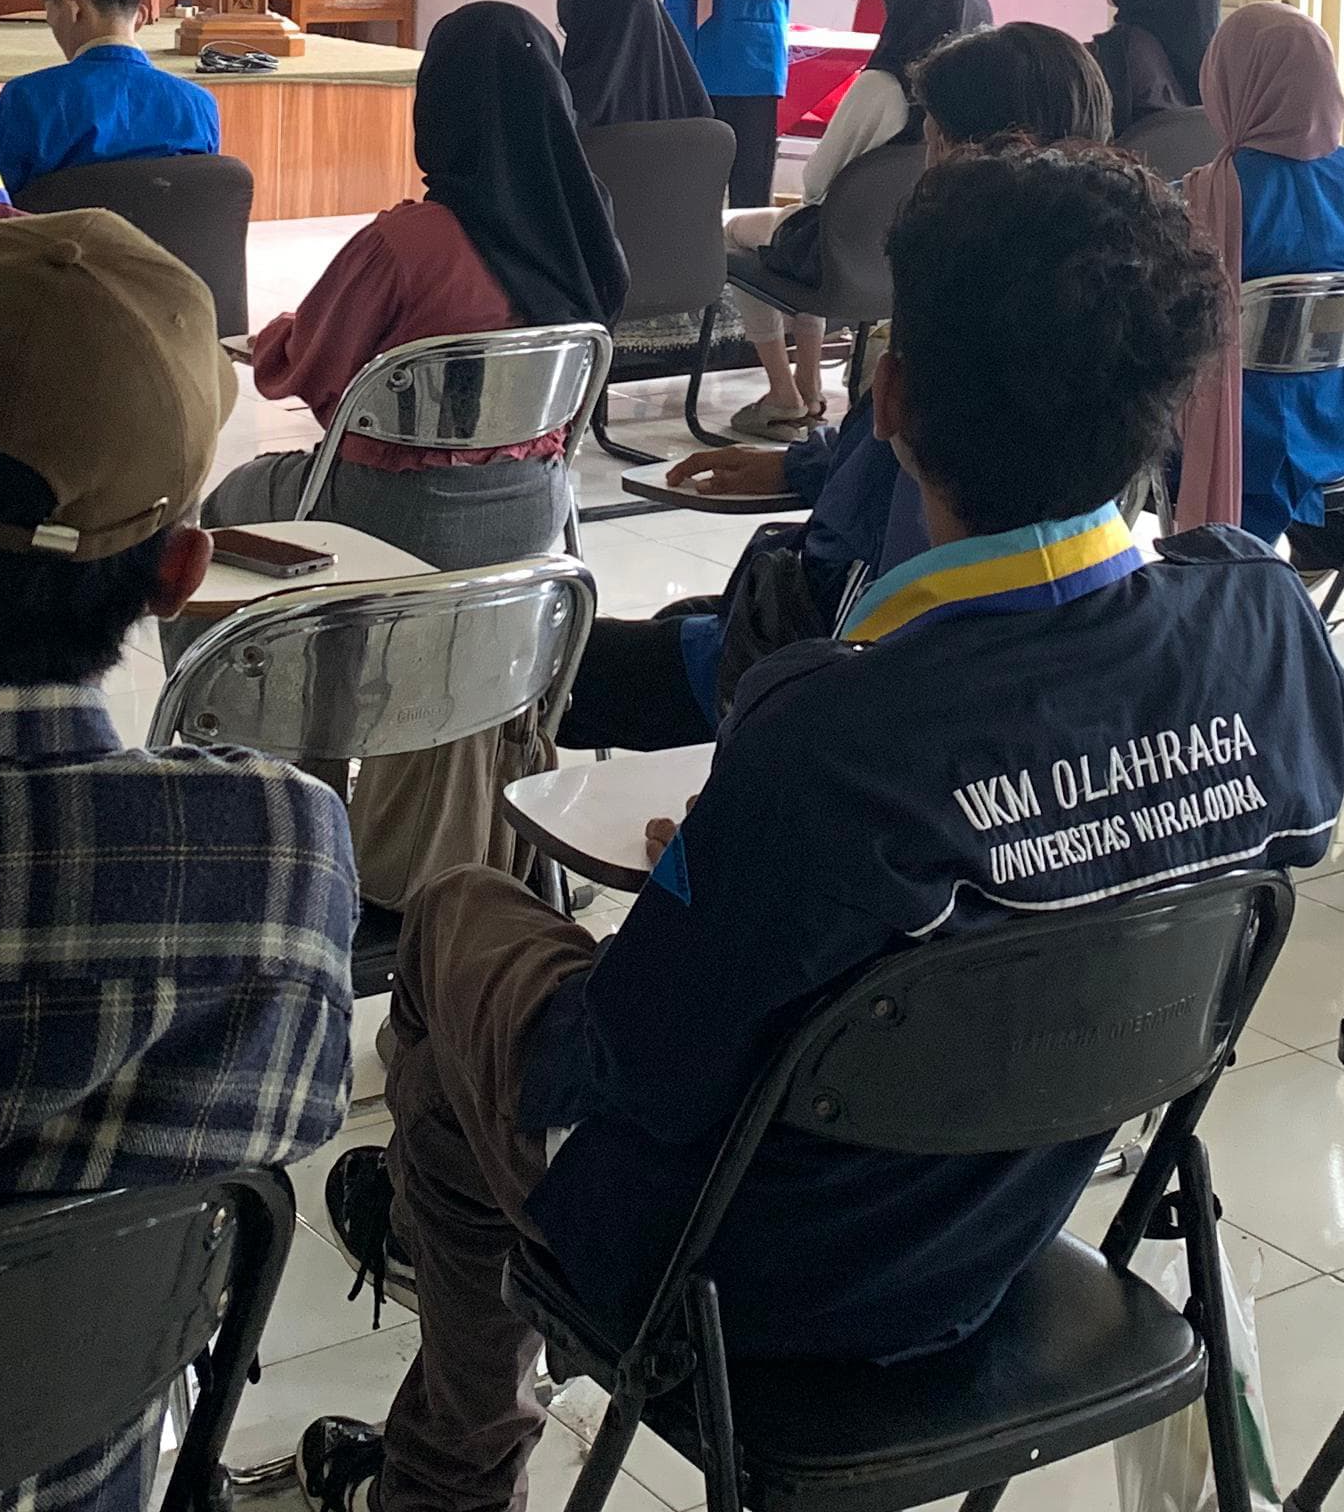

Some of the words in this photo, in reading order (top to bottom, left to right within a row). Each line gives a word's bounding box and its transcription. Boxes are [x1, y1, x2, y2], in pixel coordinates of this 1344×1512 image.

[953, 769, 1042, 832] UKM
[1052, 712, 1258, 811] OLAHRAGA
[989, 814, 1131, 885] UNIVERSITAS
[1132, 774, 1268, 844] WIRALODRA
